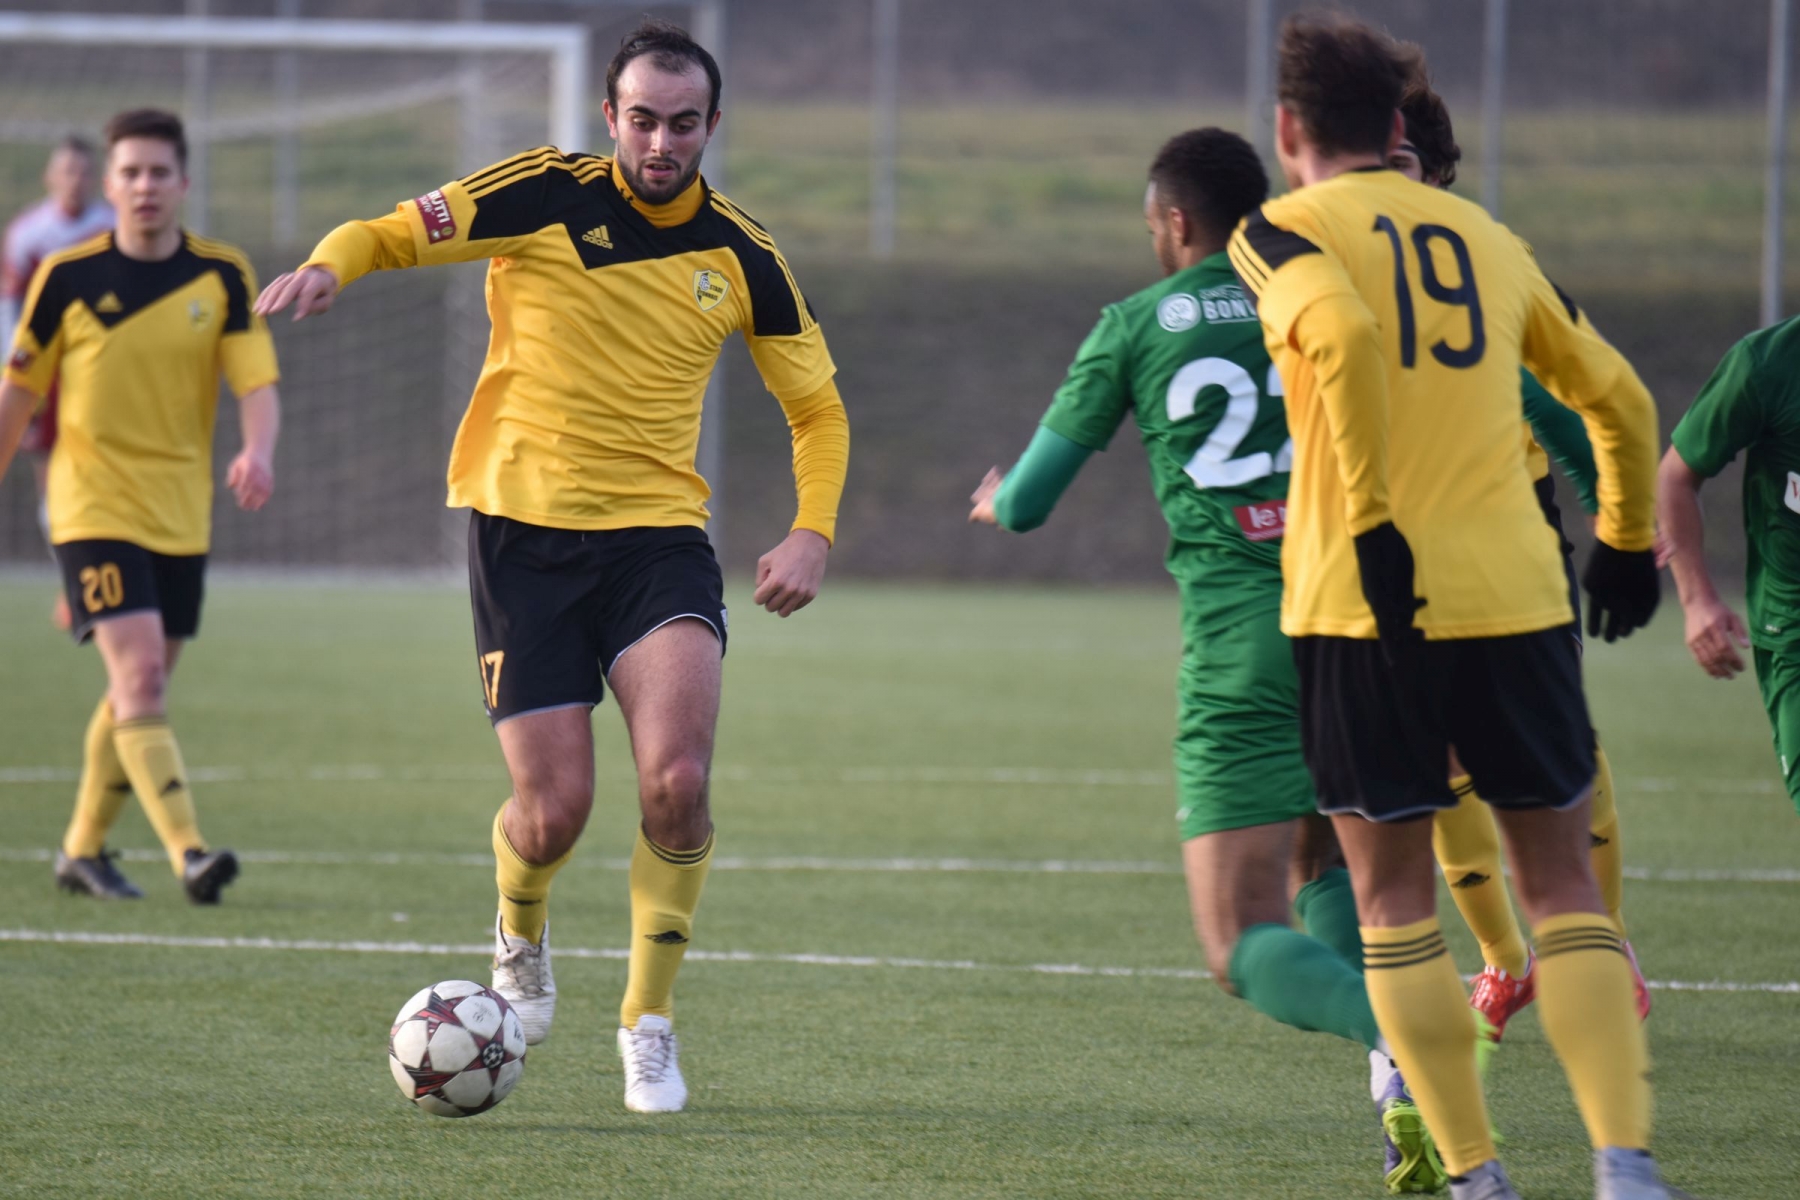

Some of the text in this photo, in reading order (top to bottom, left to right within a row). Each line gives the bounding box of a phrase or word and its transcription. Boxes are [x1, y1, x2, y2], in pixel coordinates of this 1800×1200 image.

[582, 234, 613, 249] adidas
[1372, 214, 1486, 370] 19
[79, 562, 124, 613] 20
